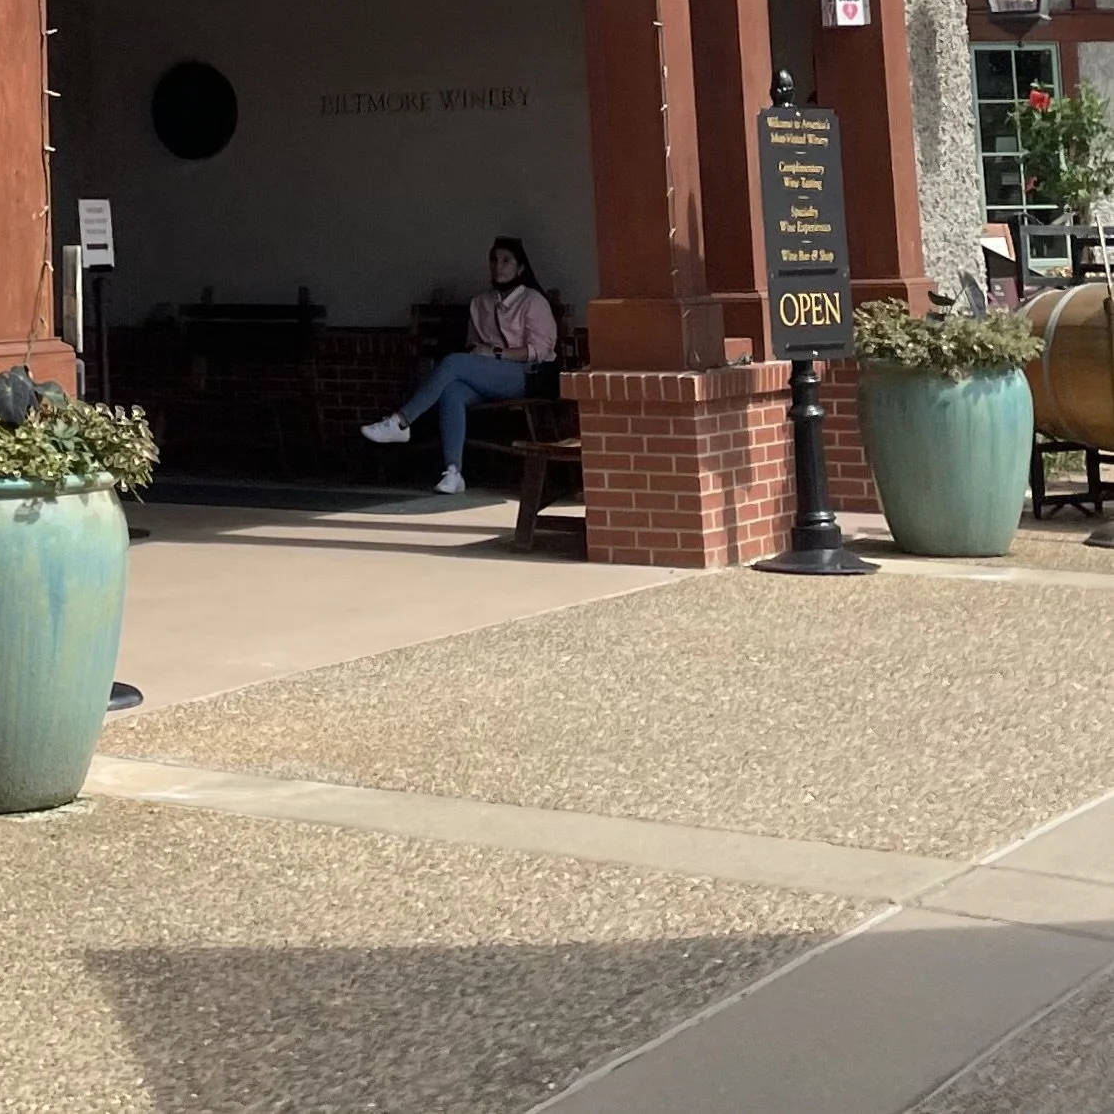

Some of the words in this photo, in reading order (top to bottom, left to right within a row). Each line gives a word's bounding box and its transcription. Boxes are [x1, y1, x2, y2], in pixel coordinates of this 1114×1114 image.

[319, 91, 431, 116] BILTMORE
[438, 86, 532, 111] WINERY
[779, 292, 842, 326] OPEN
